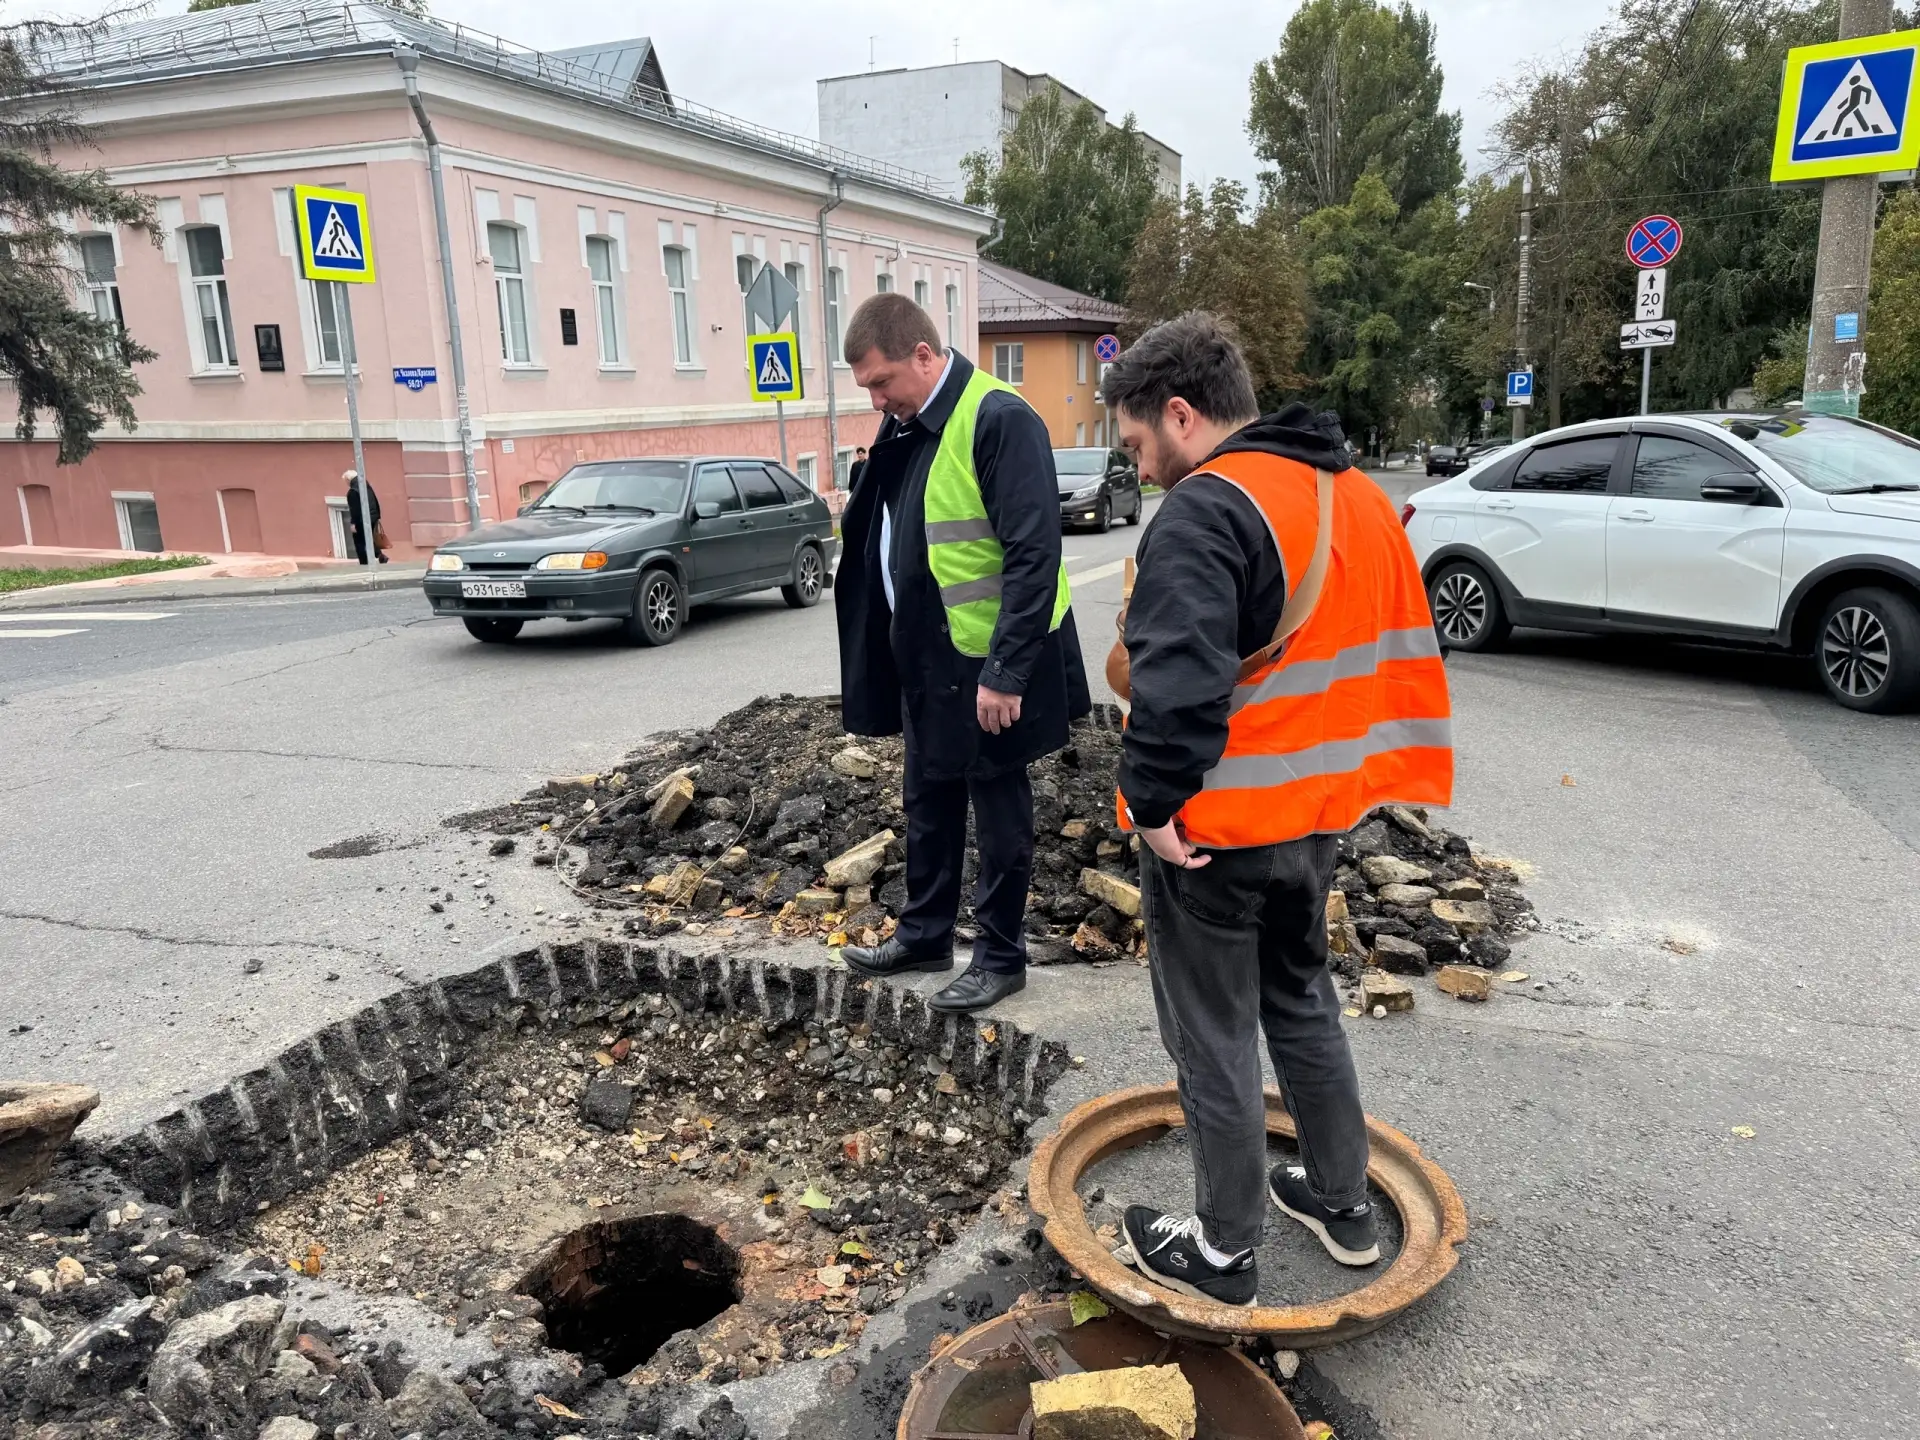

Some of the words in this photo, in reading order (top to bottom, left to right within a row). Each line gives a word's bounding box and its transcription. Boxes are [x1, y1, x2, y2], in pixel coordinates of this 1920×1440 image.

[1641, 292, 1660, 306] 20
[1514, 375, 1528, 393] P
[510, 583, 521, 592] 58
